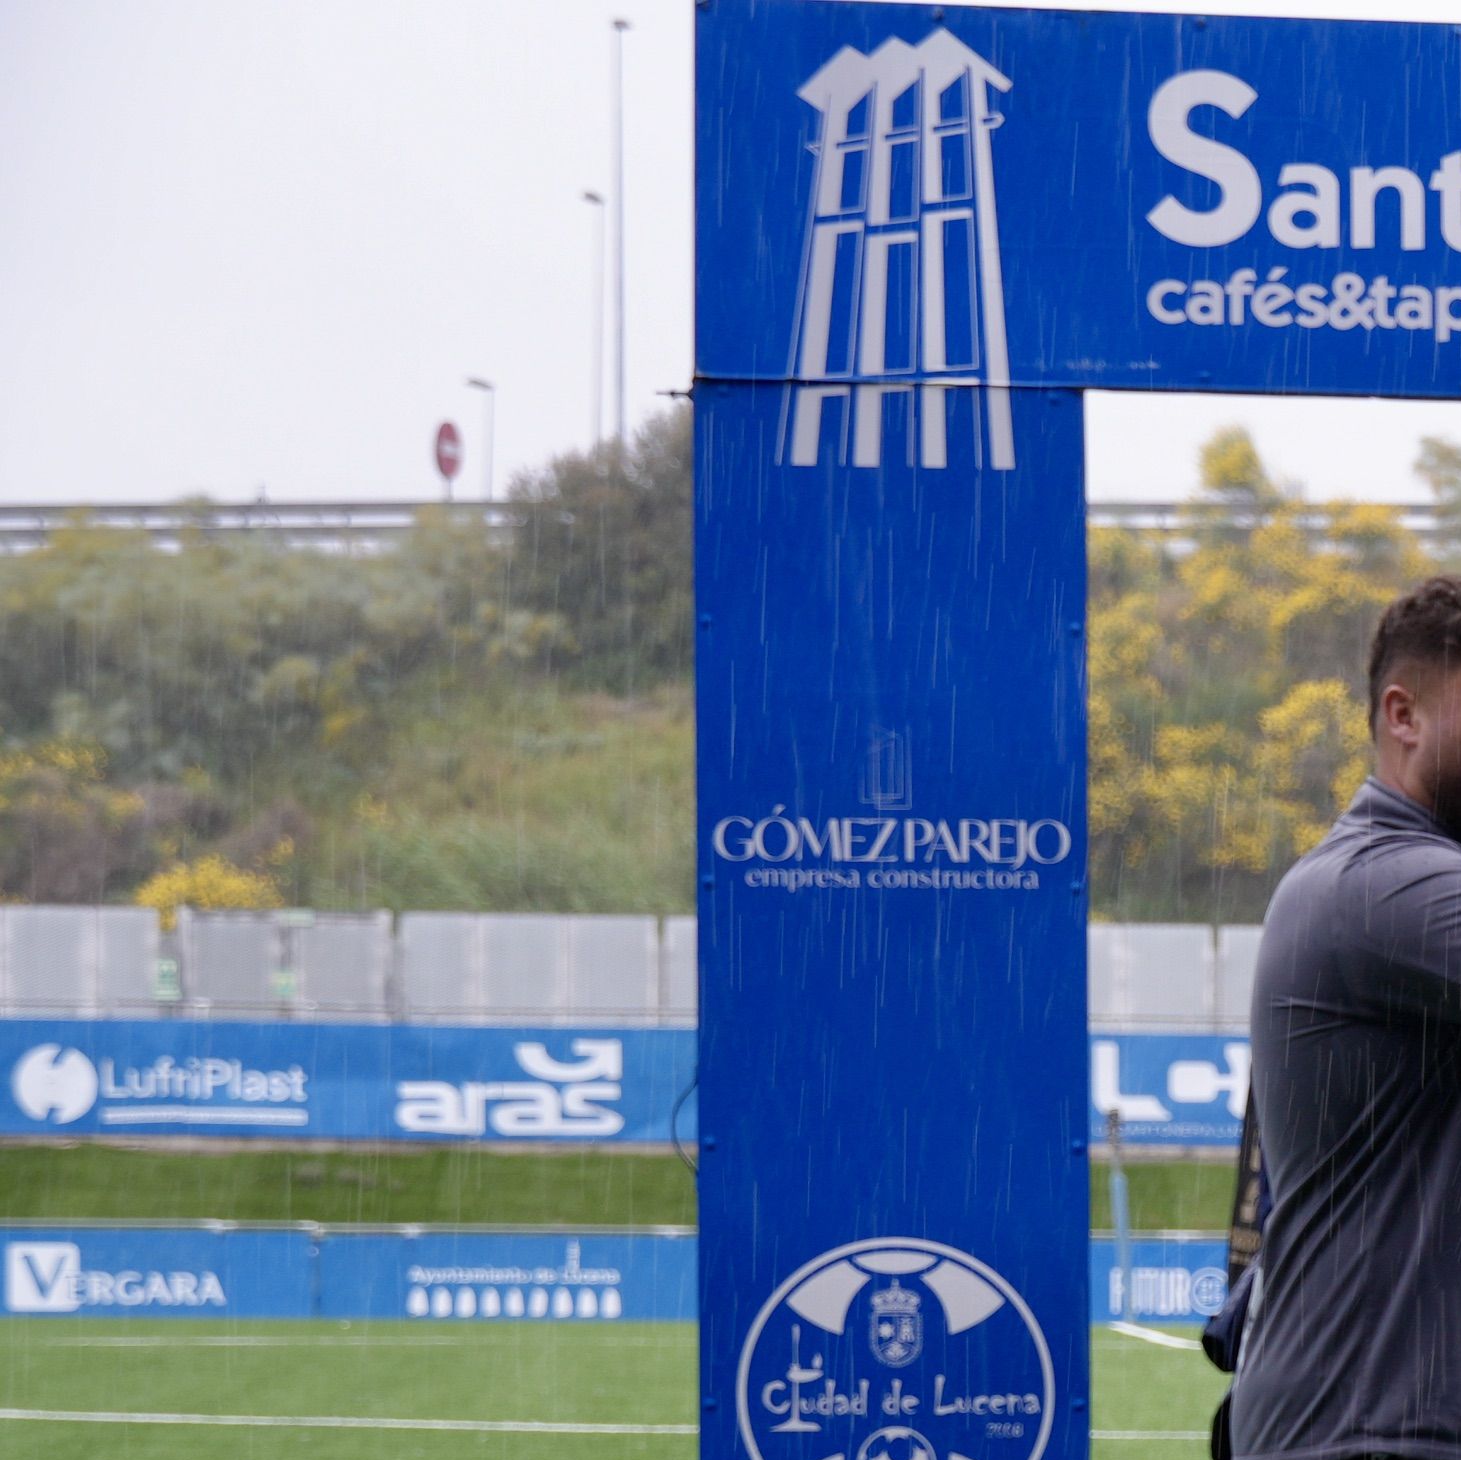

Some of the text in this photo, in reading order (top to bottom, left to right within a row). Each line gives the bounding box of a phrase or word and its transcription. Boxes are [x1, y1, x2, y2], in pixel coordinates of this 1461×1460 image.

[712, 804, 1073, 871] GÓMEZ PAREJO
[744, 865, 1040, 893] empresa constructora
[881, 1378, 920, 1416] de
[933, 1373, 1042, 1416] Lucena
